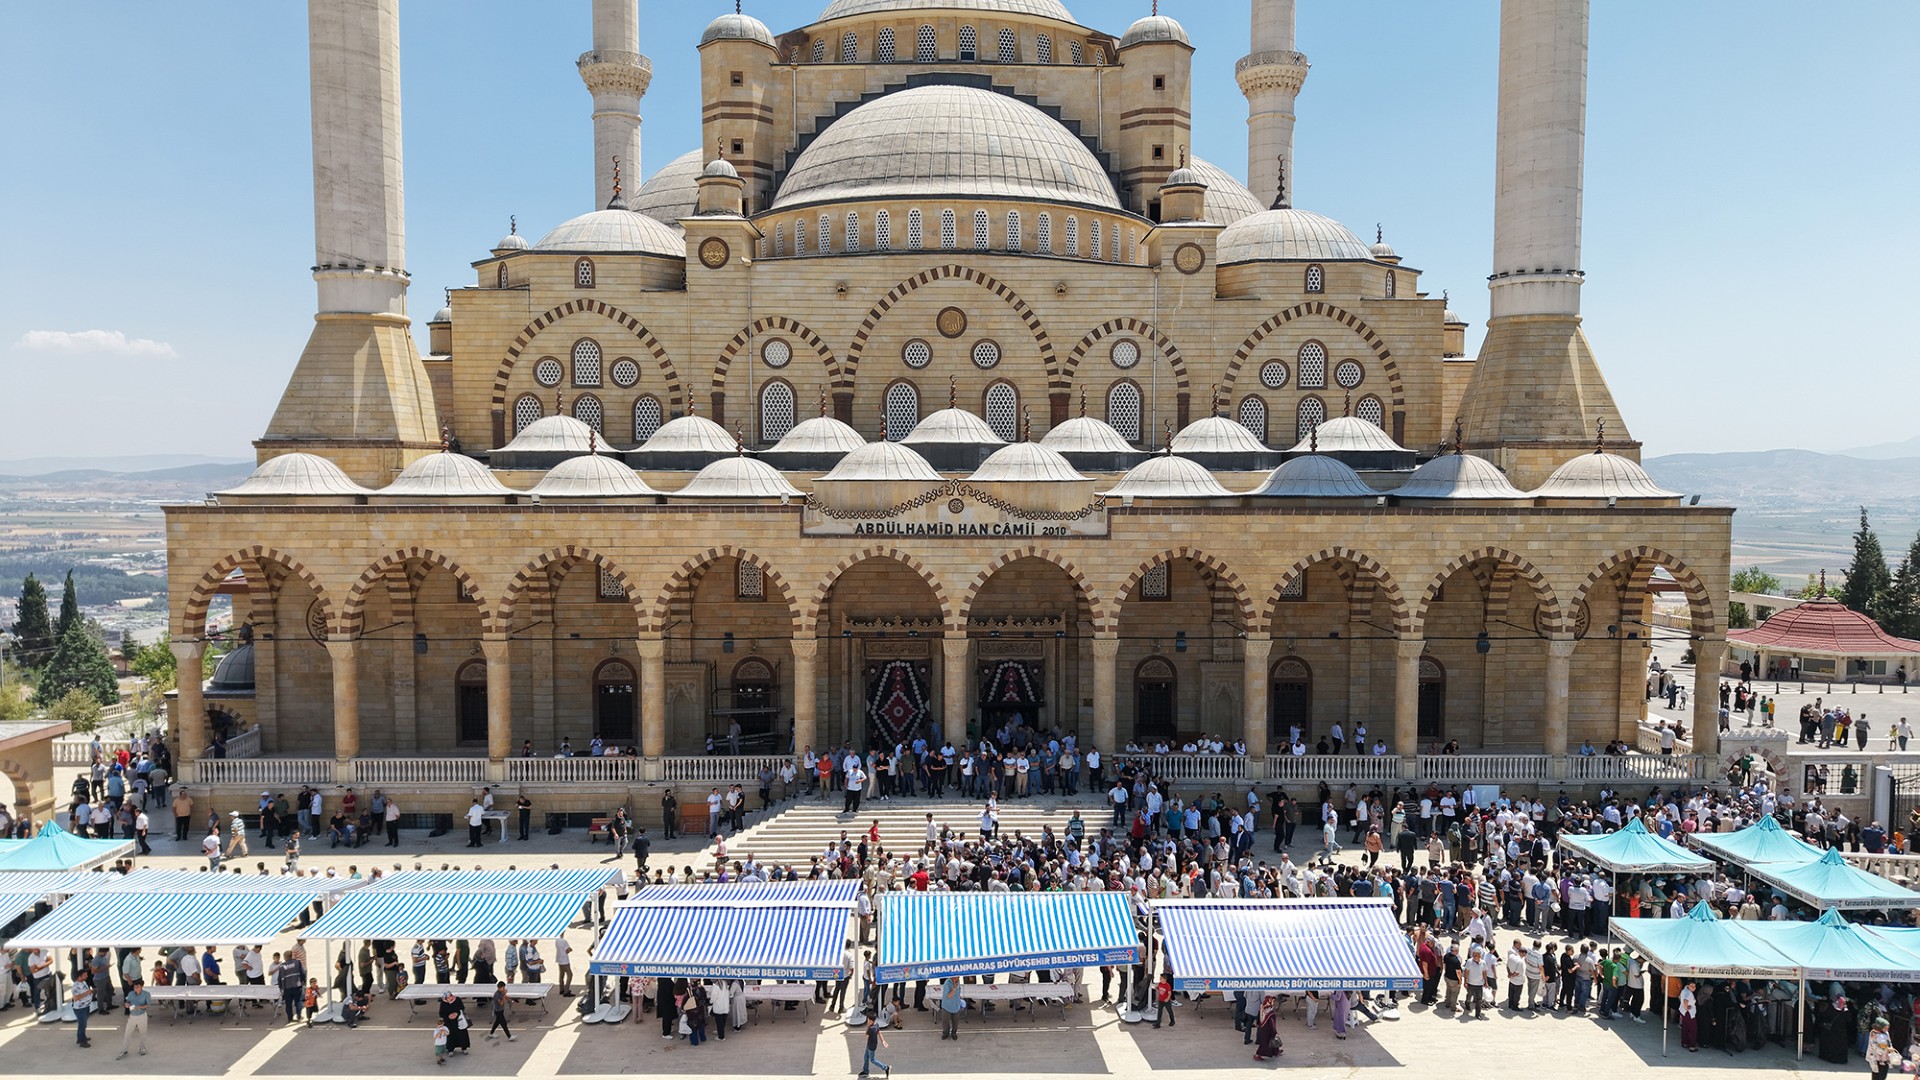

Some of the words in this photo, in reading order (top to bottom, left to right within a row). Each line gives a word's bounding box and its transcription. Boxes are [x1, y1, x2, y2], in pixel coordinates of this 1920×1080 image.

[958, 523, 989, 536] HAN
[1042, 526, 1067, 536] 2010
[918, 960, 995, 976] KAHRAMANMARAŞ
[996, 957, 1051, 970] BÜYÜKŞEHİR
[1051, 953, 1099, 965] BELEDİYESİ
[633, 966, 708, 976] KAHRAMANMARAŞ
[709, 966, 760, 977] BÜYÜKŞEHİR
[761, 968, 807, 977] BELEDİYESİ
[1217, 979, 1290, 989] KAHRAMANMARAŞ
[1291, 978, 1341, 989] BÜYÜKŞEHİR
[1343, 979, 1387, 988] BELEDİYESİ
